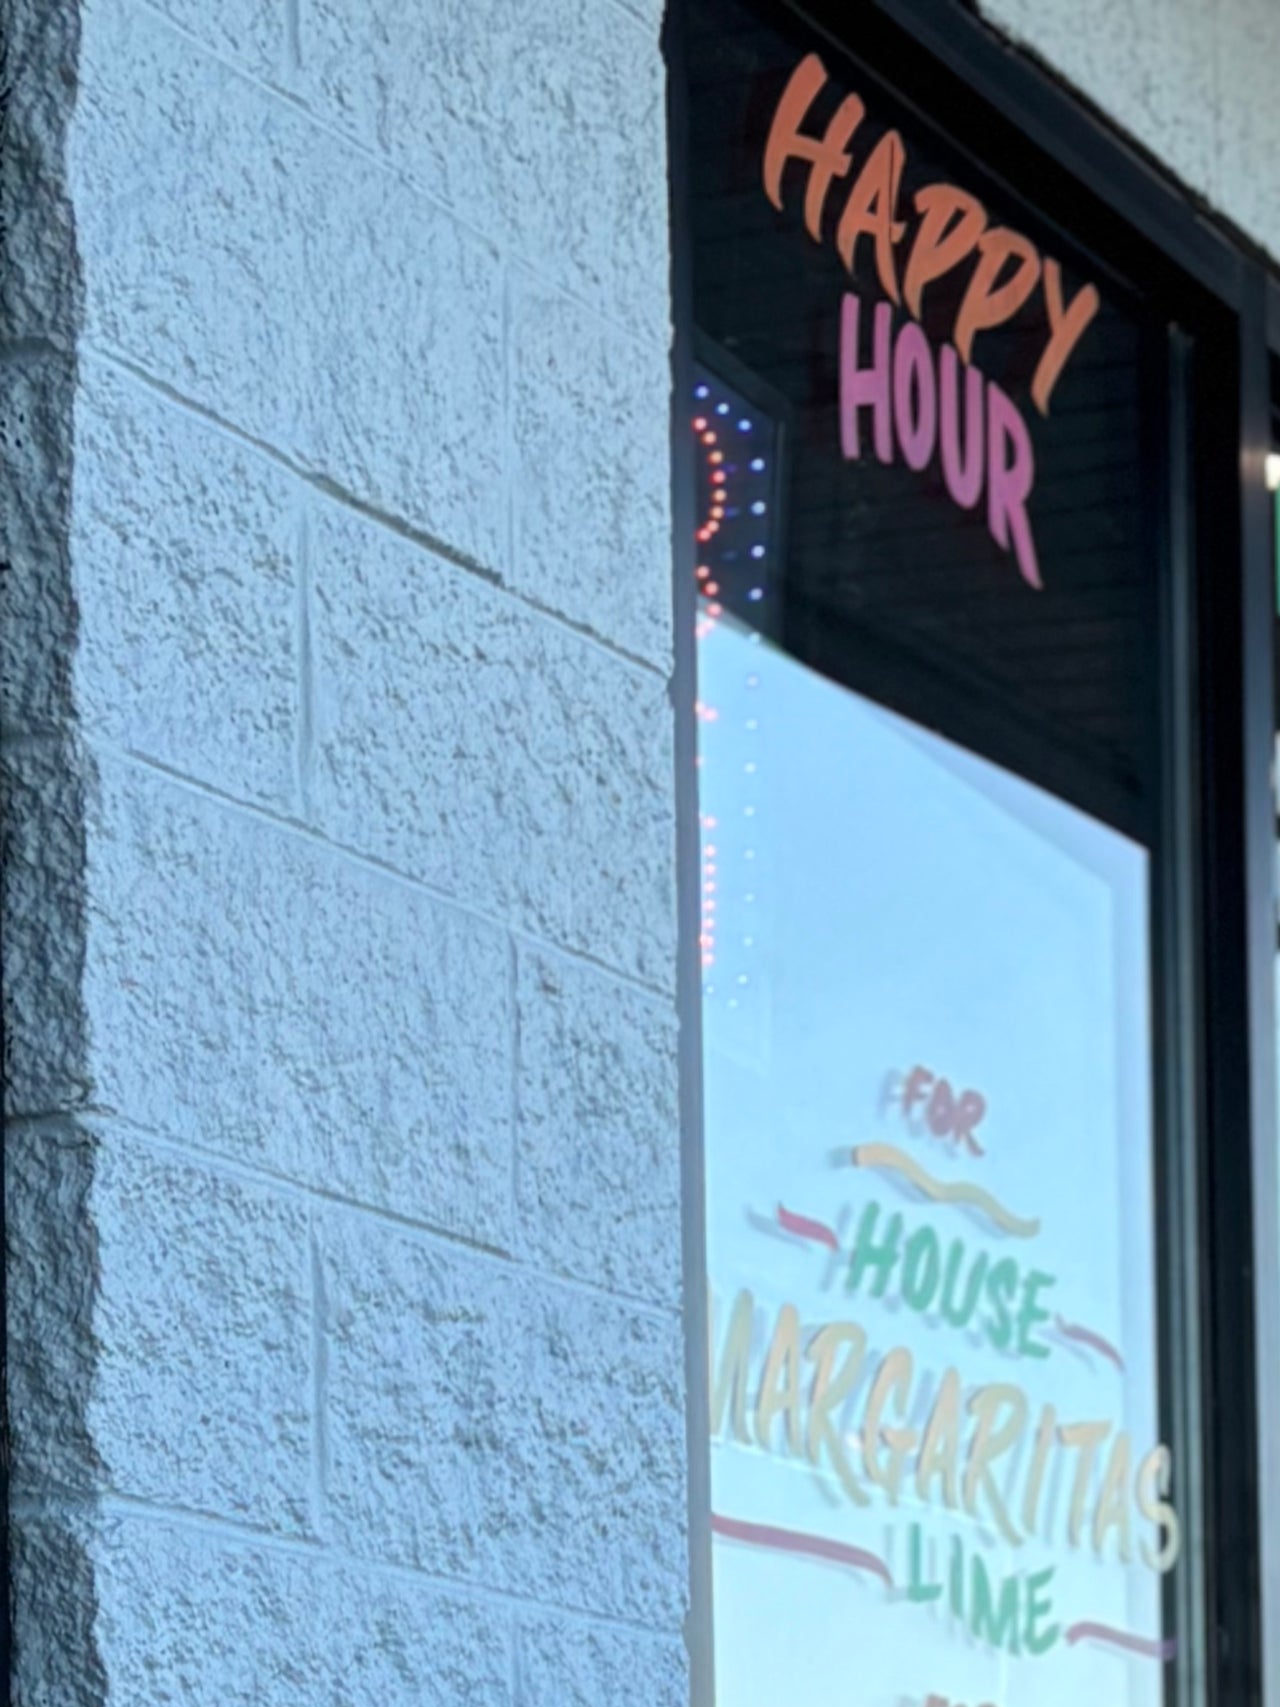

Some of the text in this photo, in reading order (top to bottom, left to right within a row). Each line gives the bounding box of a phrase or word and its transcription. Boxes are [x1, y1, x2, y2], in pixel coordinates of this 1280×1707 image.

[763, 52, 1098, 418] HAPPY
[839, 292, 1043, 591] HOUR
[901, 1066, 986, 1157] FOR
[846, 1200, 1059, 1359] HOUSE
[904, 1522, 1062, 1658] LIME
